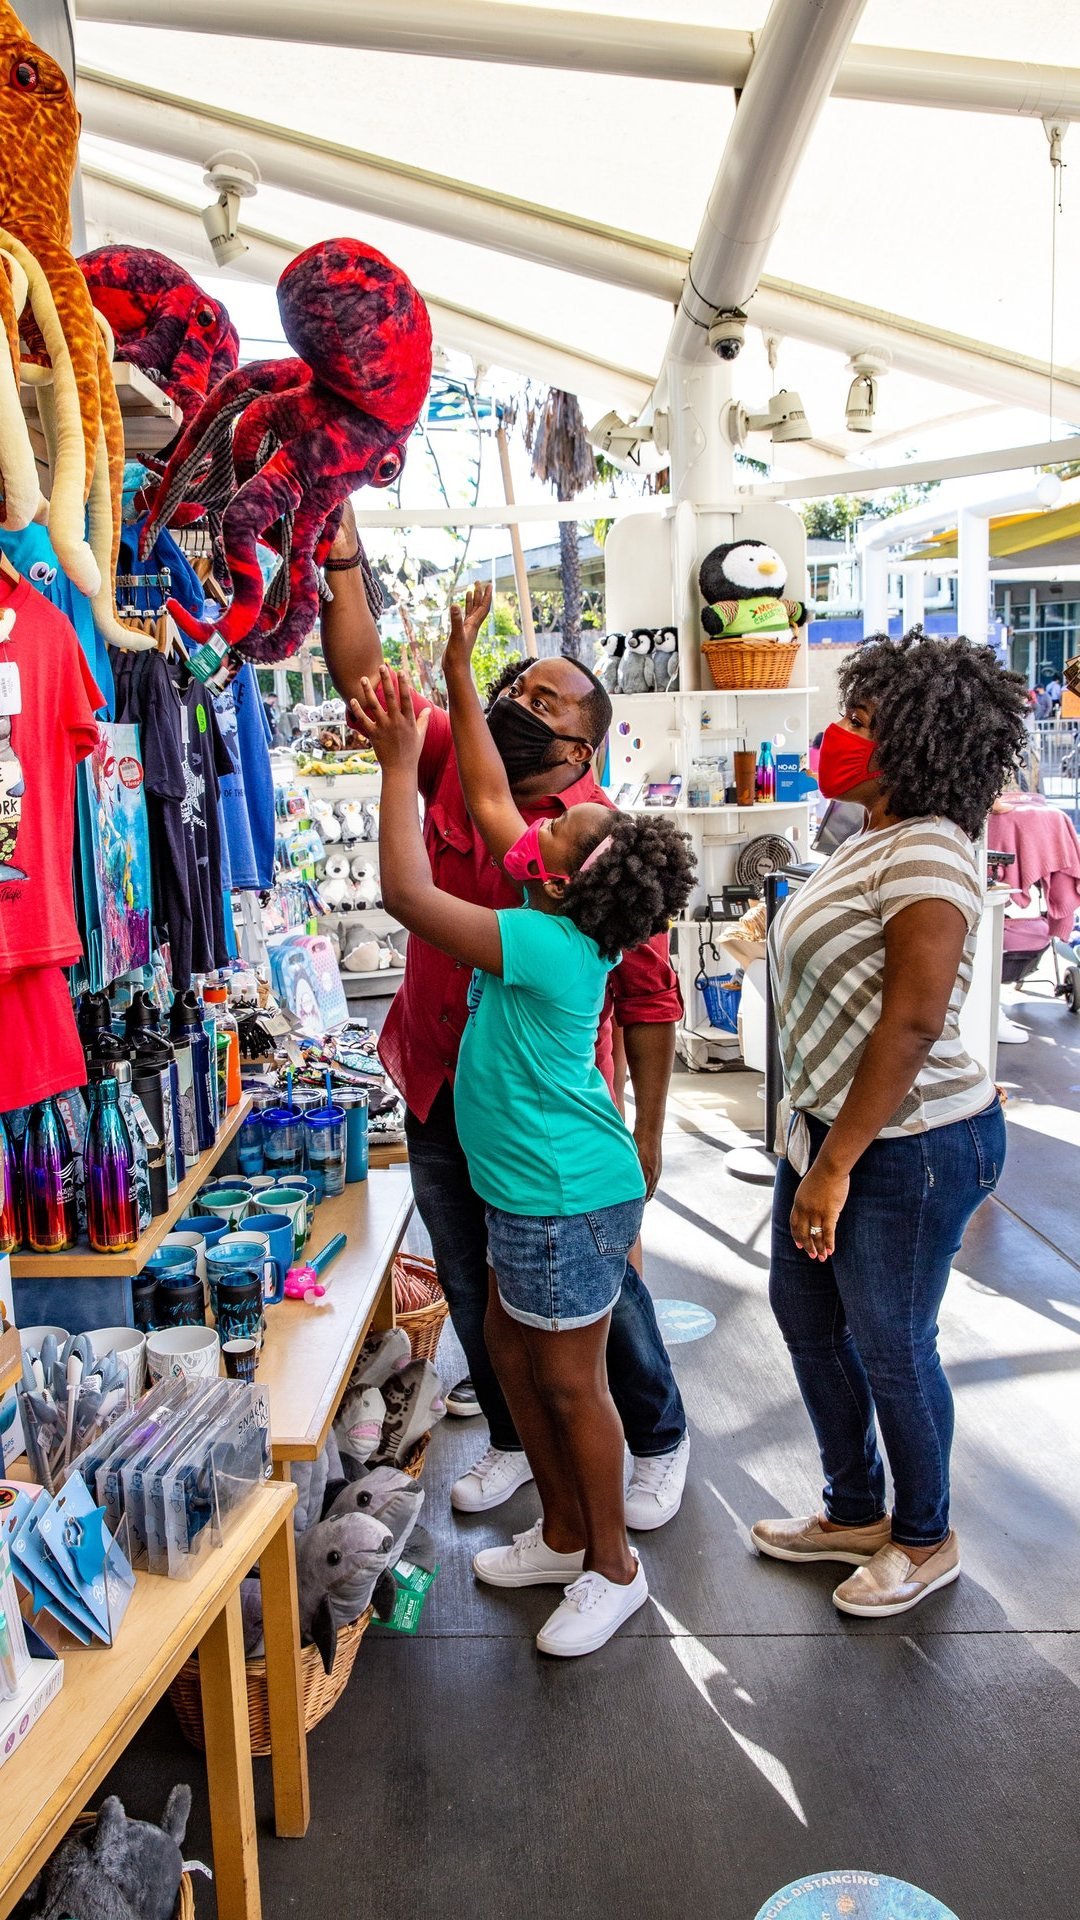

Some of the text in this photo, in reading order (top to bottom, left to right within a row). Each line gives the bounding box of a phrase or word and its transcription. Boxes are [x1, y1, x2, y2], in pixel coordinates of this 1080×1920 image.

[238, 1395, 265, 1435] SNACK
[404, 1599, 414, 1620] Fiesta
[763, 1875, 879, 1920] OCIAL DISTANCING
